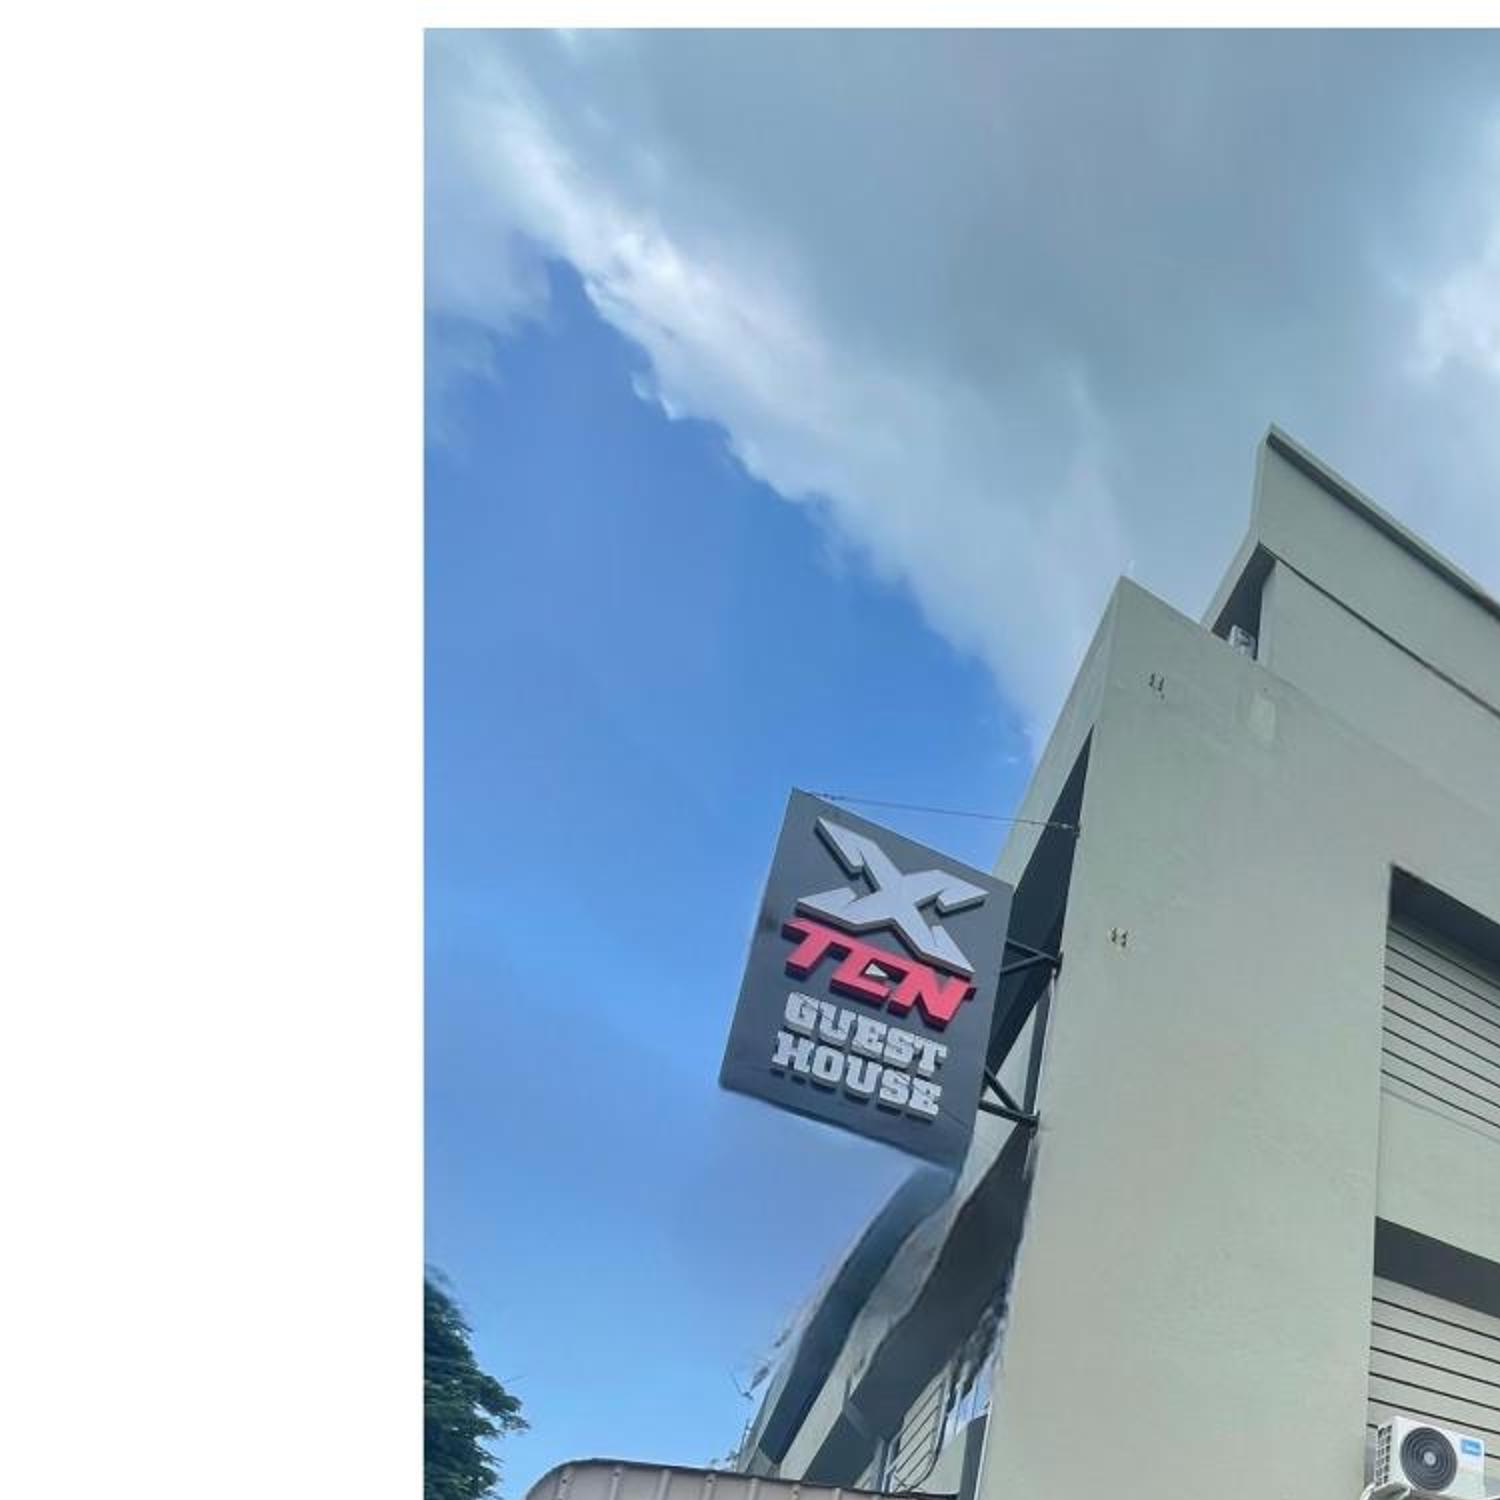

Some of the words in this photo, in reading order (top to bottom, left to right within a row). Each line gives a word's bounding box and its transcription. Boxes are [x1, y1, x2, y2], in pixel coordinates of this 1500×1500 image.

[797, 816, 989, 973] X
[772, 1031, 943, 1118] HOUSE
[784, 992, 948, 1076] GUEST
